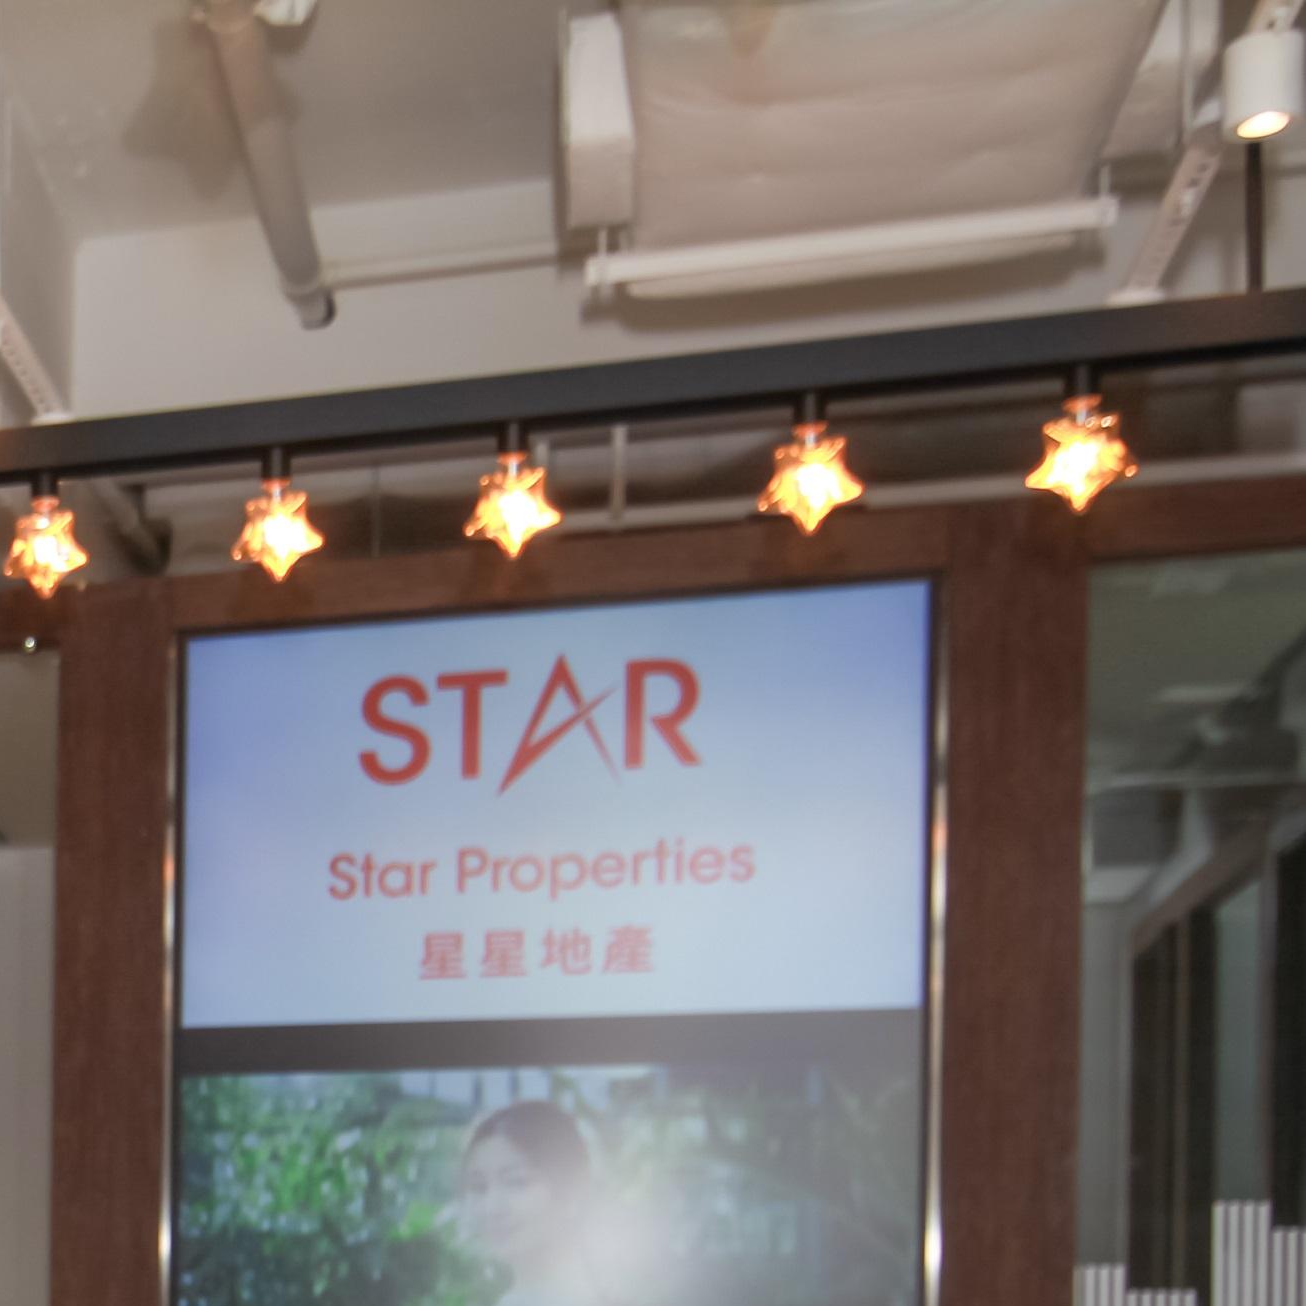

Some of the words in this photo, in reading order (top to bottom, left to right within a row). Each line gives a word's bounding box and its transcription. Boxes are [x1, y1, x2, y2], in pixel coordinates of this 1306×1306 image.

[358, 653, 702, 797] STAR
[328, 852, 437, 900] Star
[456, 837, 757, 900] Properties
[419, 924, 656, 981] 星星地產
